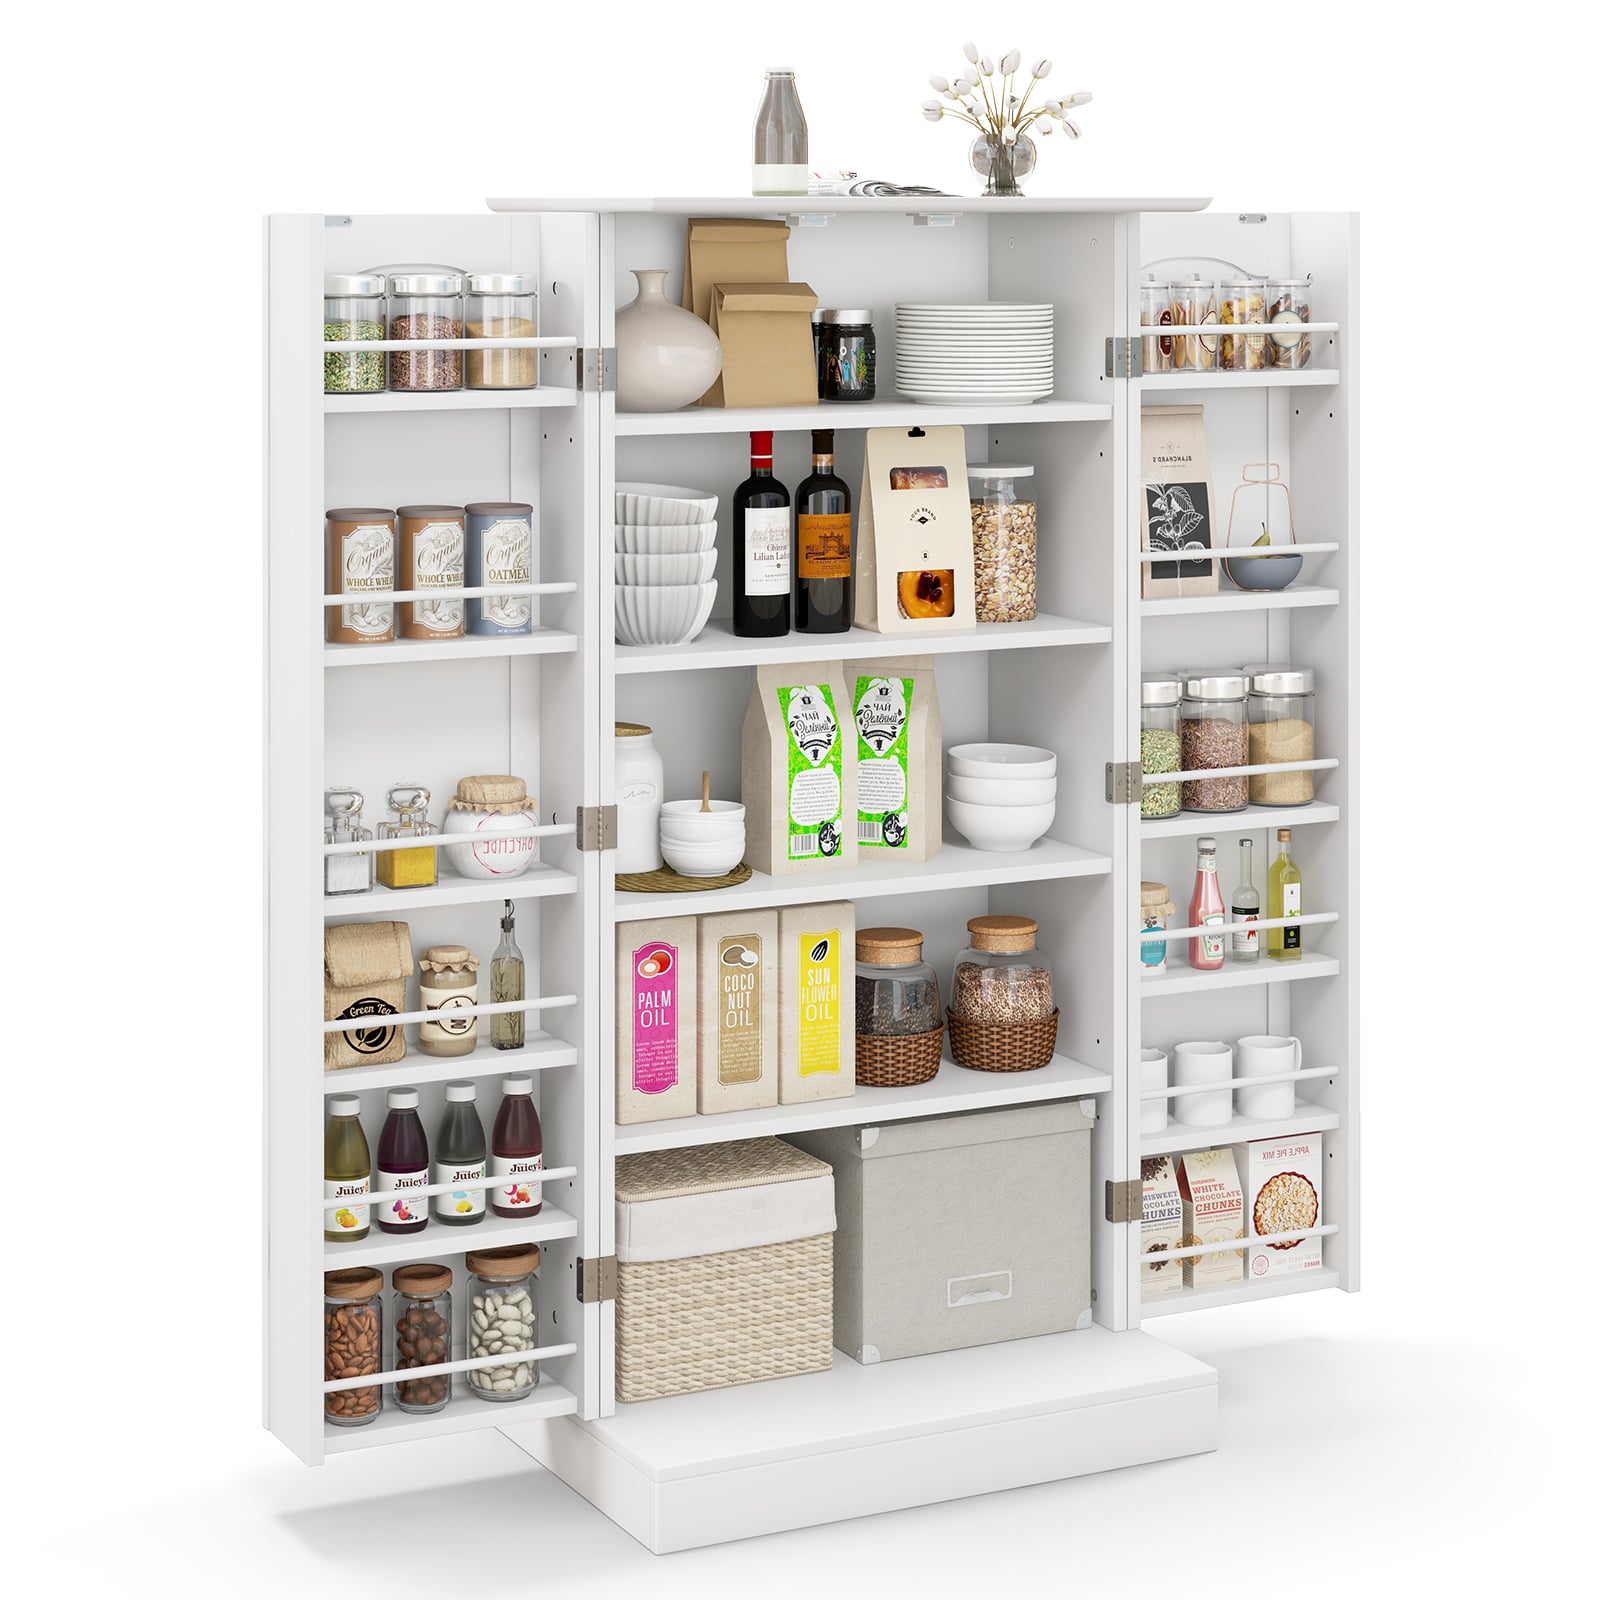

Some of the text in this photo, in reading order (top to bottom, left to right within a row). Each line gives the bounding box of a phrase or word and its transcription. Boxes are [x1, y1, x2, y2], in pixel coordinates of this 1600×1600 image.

[754, 552, 775, 561] Lilian
[417, 574, 445, 583] WHOLE
[488, 567, 530, 580] OATMEAL
[346, 578, 374, 587] WHOLE
[873, 702, 892, 712] ЧАЙ
[801, 710, 820, 721] ЧАЙ
[863, 709, 898, 730] Зелёный
[796, 718, 830, 740] Зелёный
[724, 973, 755, 993] COCO
[807, 967, 831, 985] SUN
[638, 990, 672, 1010] PALM
[728, 992, 751, 1010] NUT
[801, 984, 837, 1004] FLOWER
[350, 1003, 392, 1018] Green Tea
[805, 1003, 833, 1022] OIL
[640, 1009, 670, 1028] OIL
[725, 1010, 754, 1028] OIL
[510, 1162, 538, 1173] Juicy
[453, 1170, 481, 1180] Juicy
[395, 1178, 423, 1188] Juicy
[1192, 1182, 1226, 1194] WHITE
[336, 1185, 365, 1196] Juicy
[1143, 1190, 1178, 1201] MISWEET
[1194, 1189, 1241, 1203] CHOCOLATE
[1143, 1199, 1181, 1210] OCOLATE
[1195, 1198, 1242, 1213] CHUNKS
[1143, 1206, 1181, 1220] HUNKS
